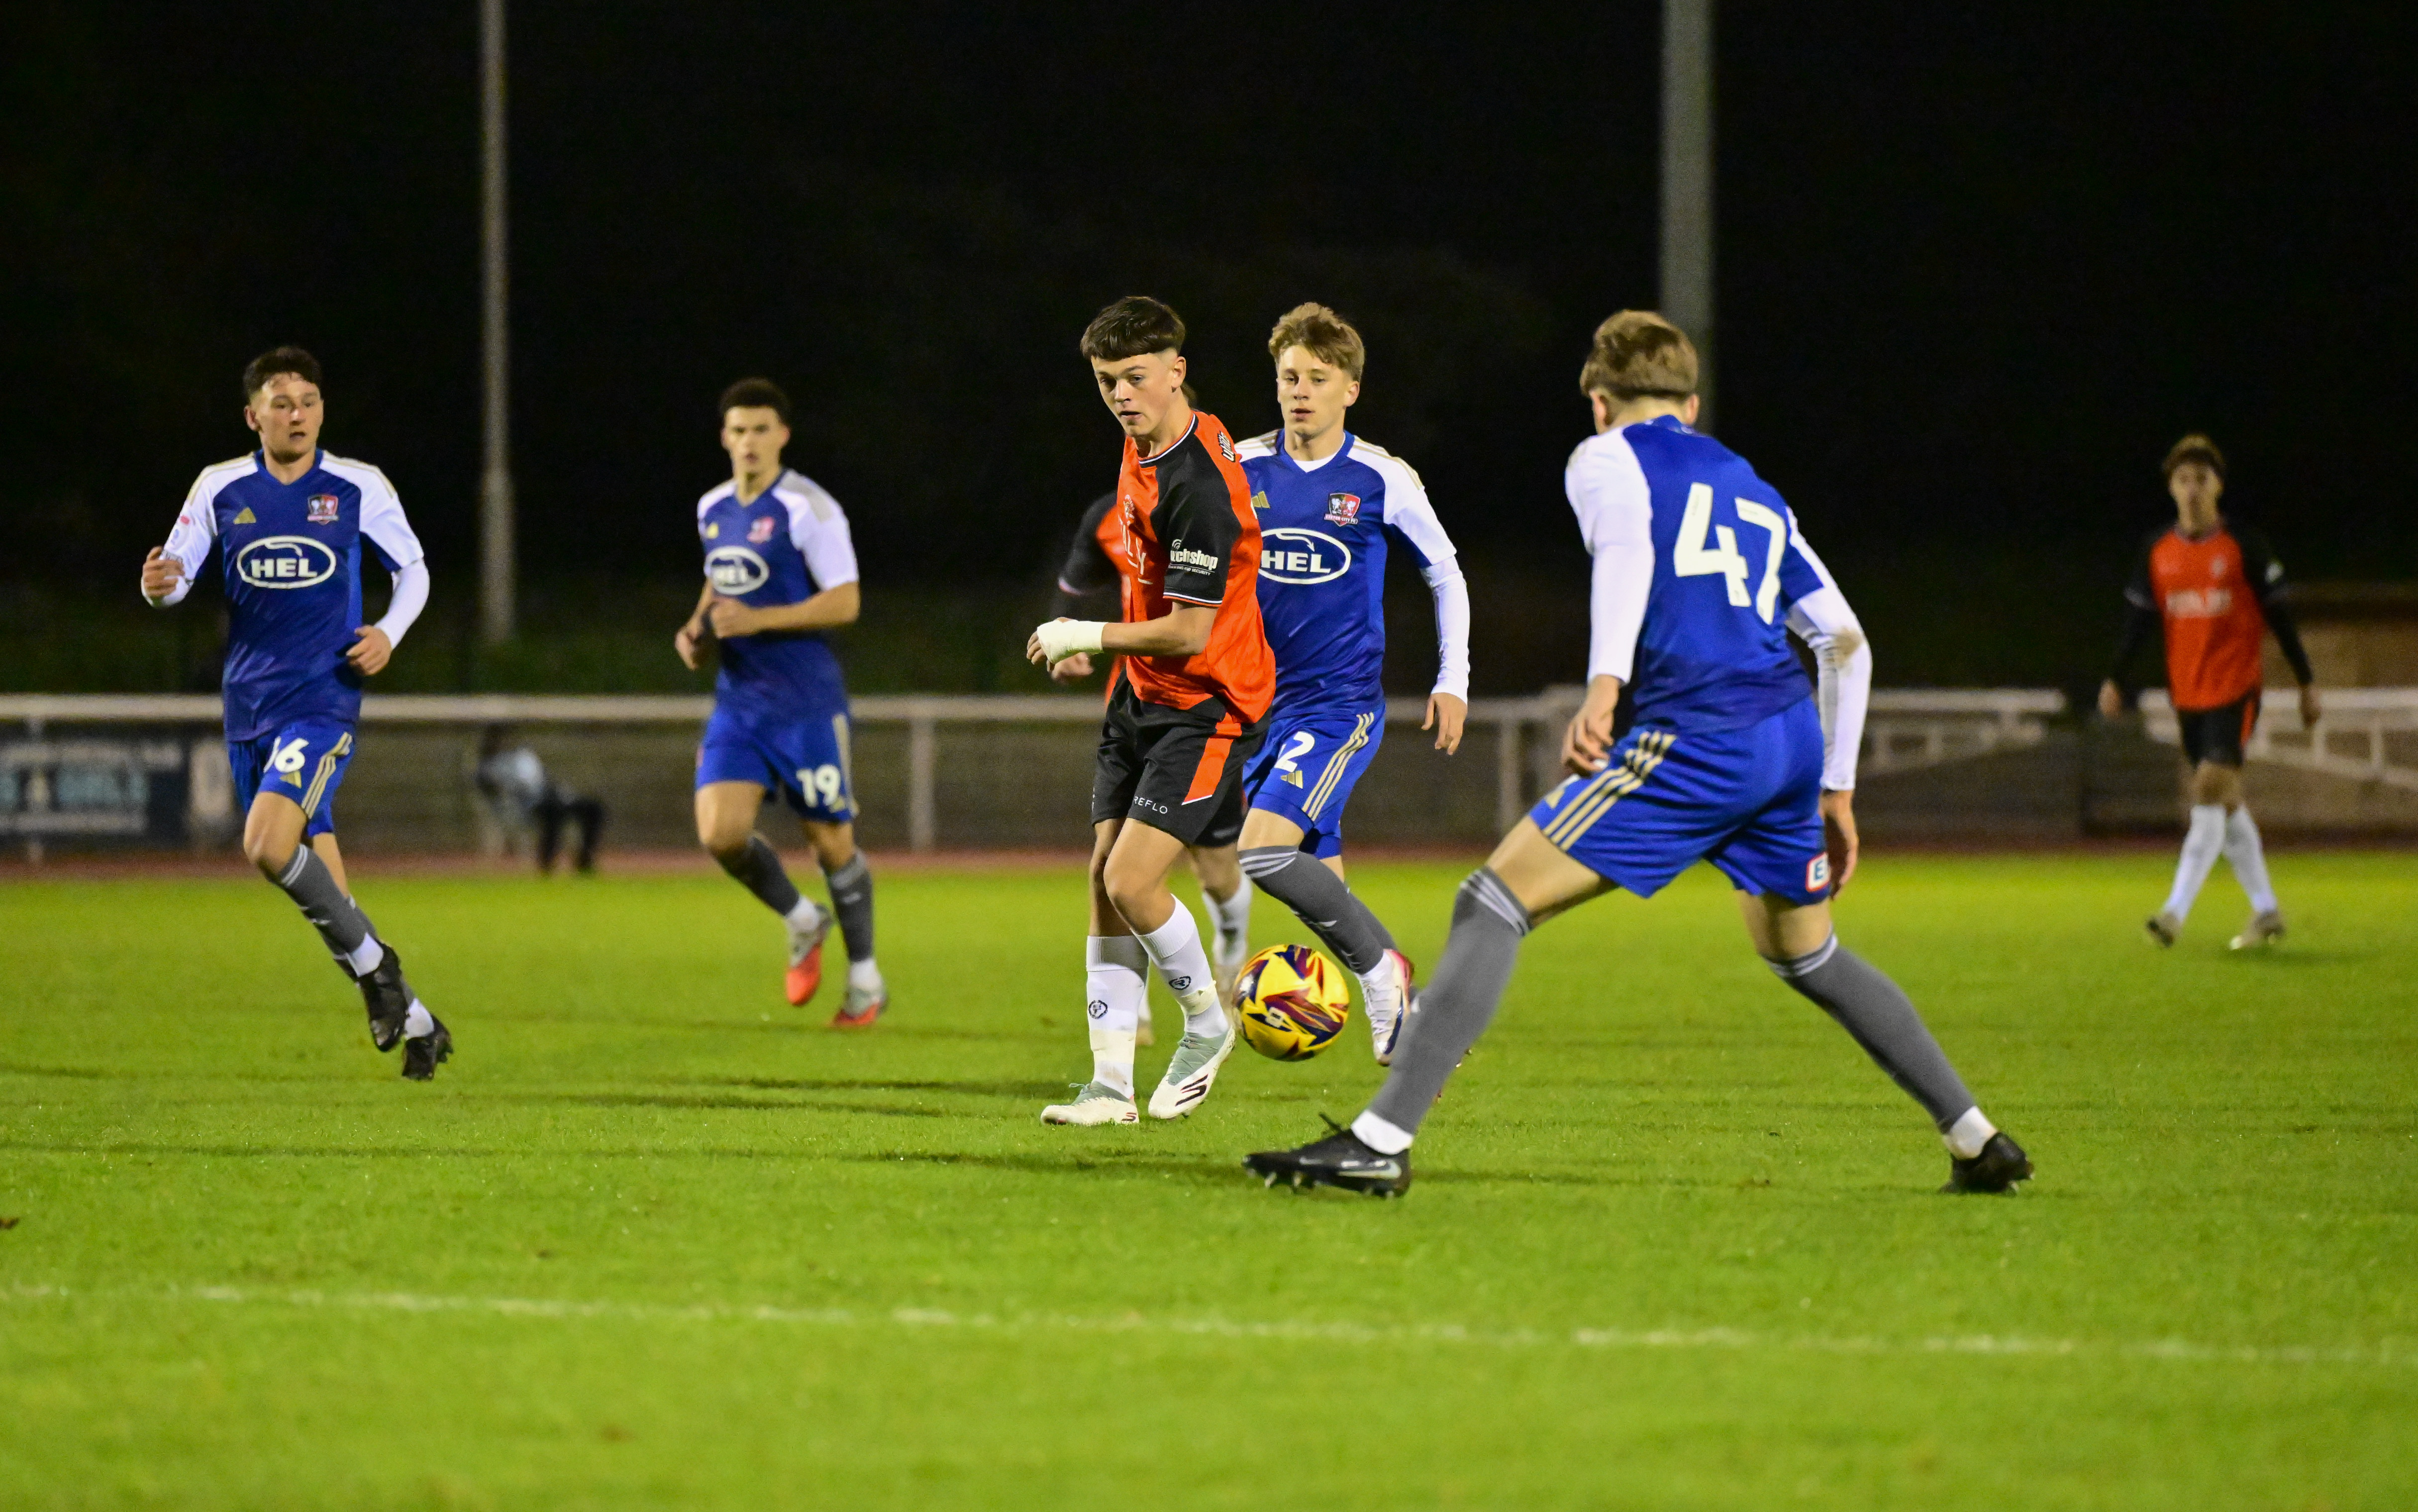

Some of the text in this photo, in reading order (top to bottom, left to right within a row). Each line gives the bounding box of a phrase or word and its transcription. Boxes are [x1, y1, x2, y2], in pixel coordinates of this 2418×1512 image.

[251, 557, 318, 578] HEL
[1261, 550, 1331, 573] HEL
[1674, 482, 1786, 625] 47
[797, 764, 841, 808] 19
